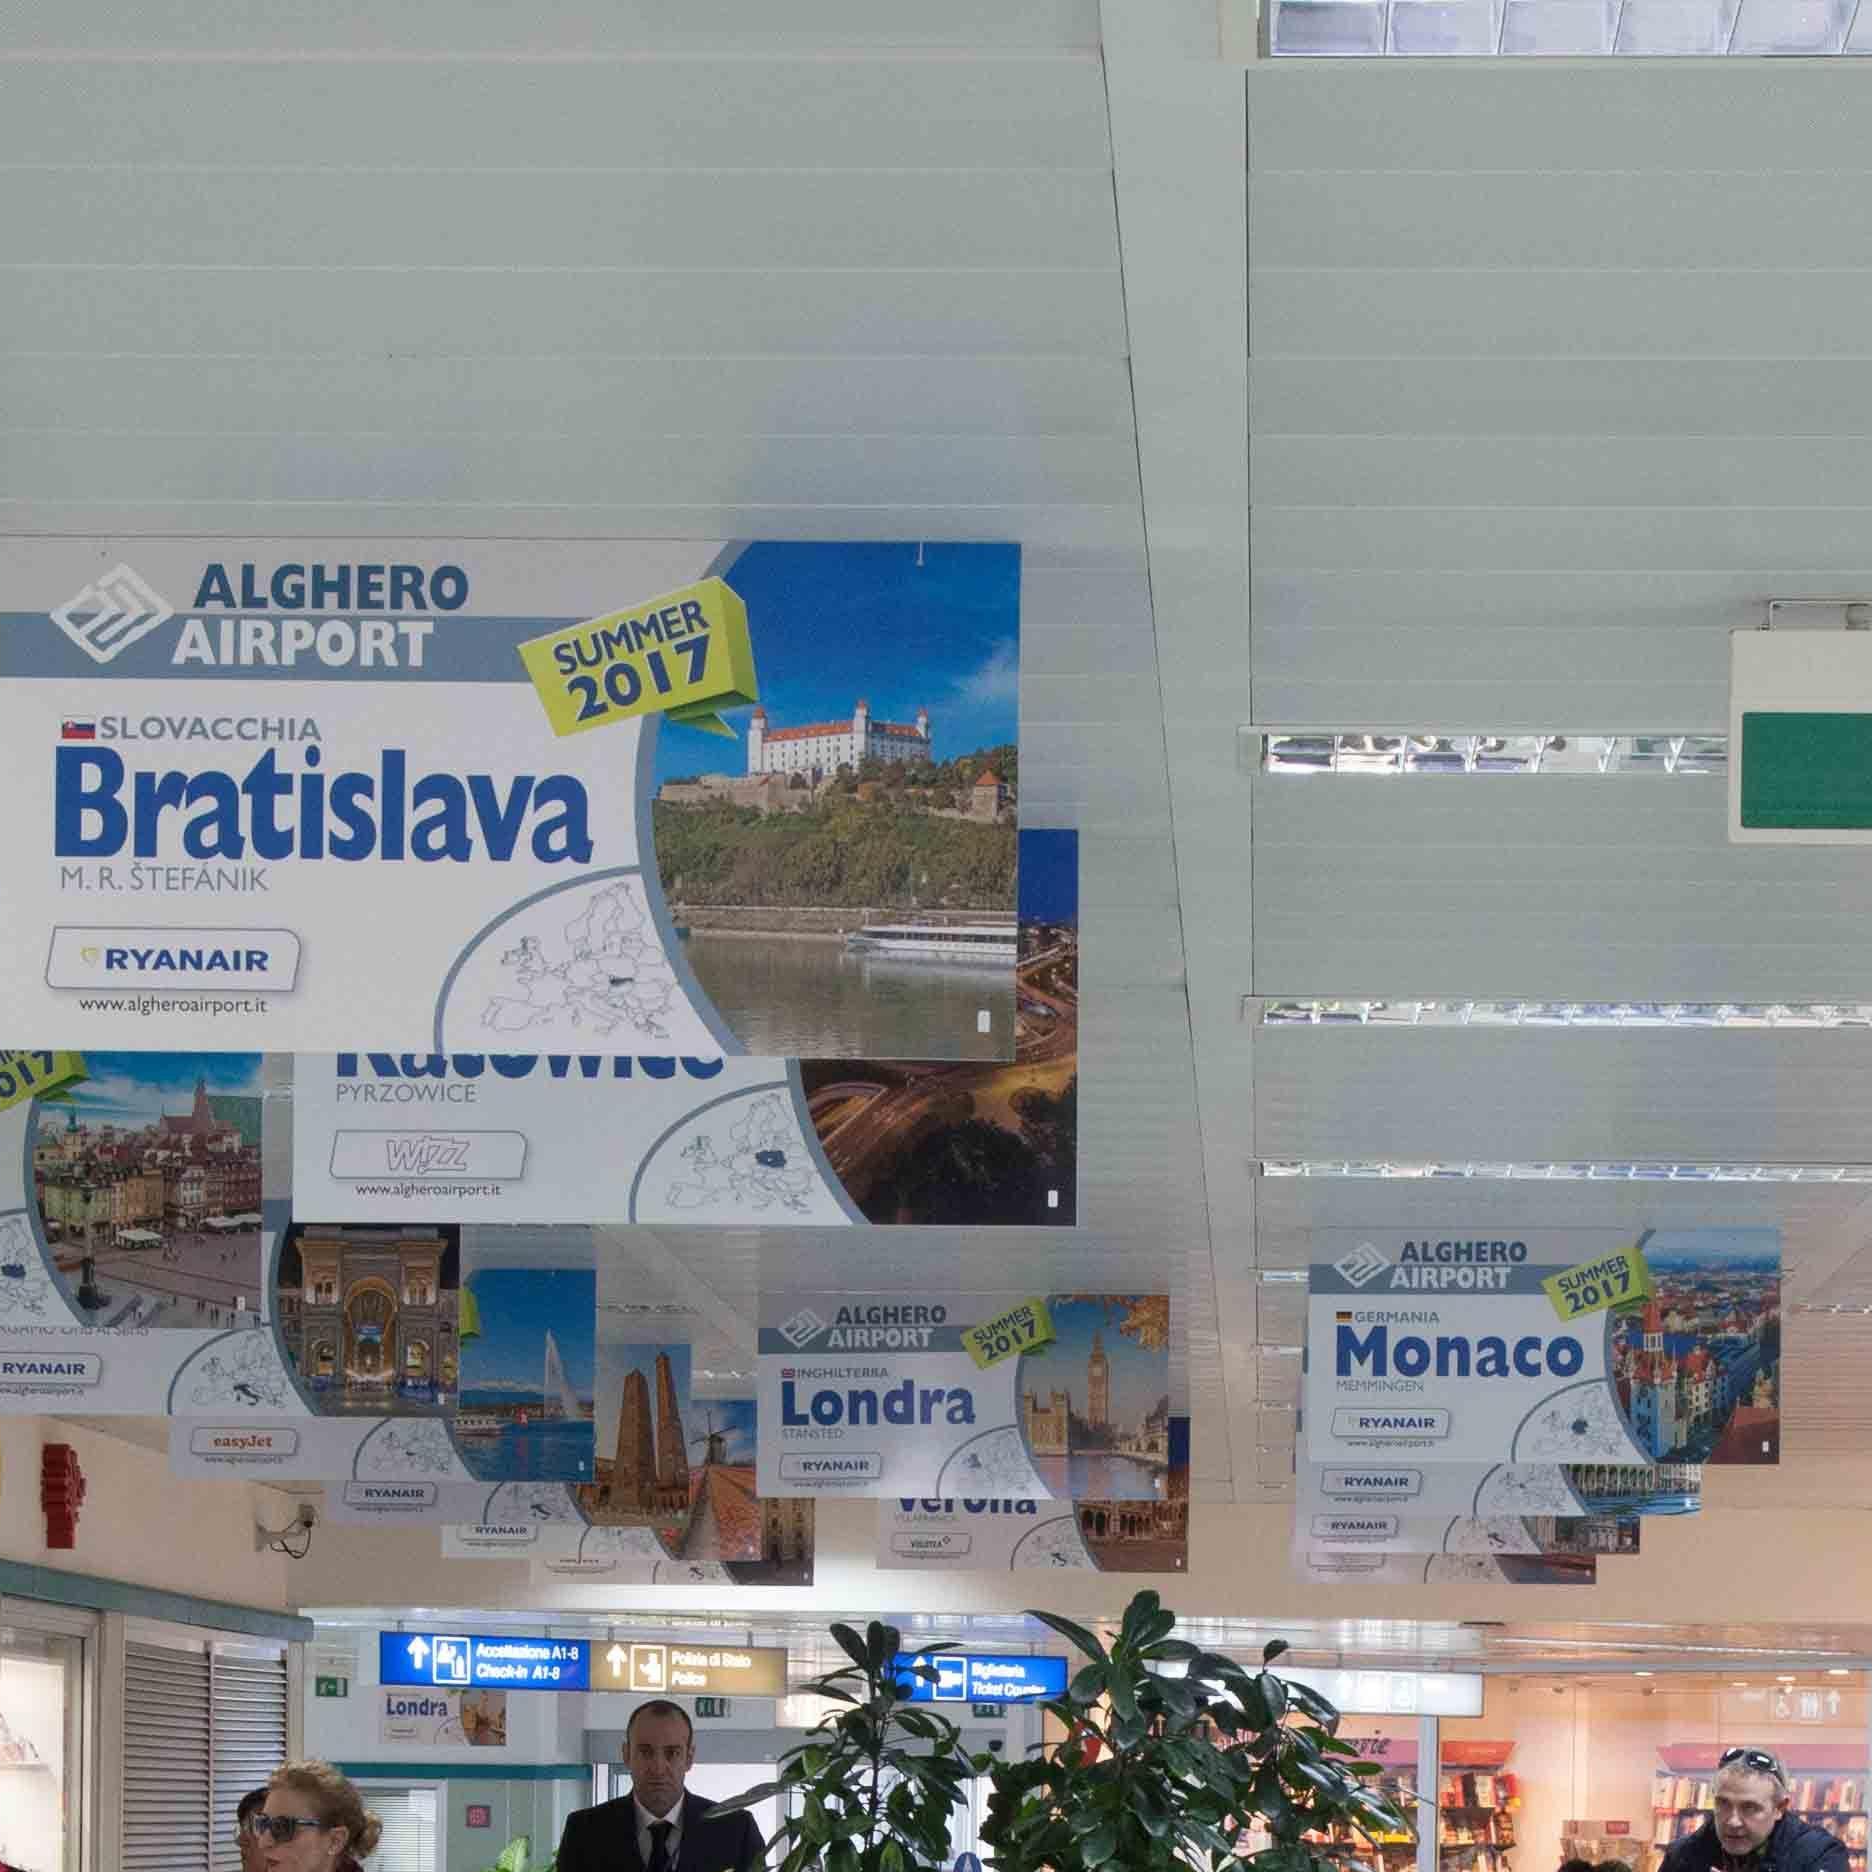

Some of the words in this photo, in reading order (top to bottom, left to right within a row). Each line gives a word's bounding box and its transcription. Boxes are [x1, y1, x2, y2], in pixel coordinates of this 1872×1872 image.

[192, 562, 469, 612] ALGHERO
[170, 620, 435, 669] AIRPORT
[551, 599, 709, 678] SUMMER
[565, 637, 711, 718] 2017
[100, 716, 322, 741] SLOVACCHIA
[53, 745, 594, 863] Bratislava
[60, 866, 92, 891] M.
[98, 866, 124, 891] R.
[128, 857, 269, 892] ŠTEFÁNIK
[104, 948, 269, 974] RYANAIR
[79, 994, 268, 1018] www.algheroairport.it
[335, 1083, 477, 1104] PYRZOWICE
[355, 1182, 501, 1200] www.algheroairport.it
[1400, 1241, 1527, 1263] ALGHERO
[1390, 1267, 1512, 1289] AIRPORT
[1557, 1256, 1627, 1292] SUMMER
[1565, 1270, 1630, 1312] 2017
[836, 1304, 947, 1325] ALGHERO
[972, 1306, 1034, 1345] SUMMER
[1355, 1311, 1440, 1323] GERMANIA
[828, 1327, 934, 1349] AIRPORT
[980, 1320, 1038, 1361] 2017
[1336, 1325, 1584, 1378] Monaco
[2, 1362, 85, 1375] RYANAIR
[796, 1367, 889, 1378] INGHILTERRA
[1336, 1380, 1425, 1393] MEMMINGEN
[781, 1379, 976, 1426] Londra
[1359, 1417, 1435, 1428] RYANAIR
[214, 1436, 273, 1450] easyJet
[802, 1461, 869, 1472] RYANAIR
[1344, 1477, 1409, 1487] RYANAIR
[364, 1488, 424, 1499] RYANAIR
[1331, 1520, 1388, 1530] RYANAIR
[552, 1645, 578, 1660] A1-8
[532, 1664, 560, 1680] A1-8
[387, 1696, 448, 1716] Londra
